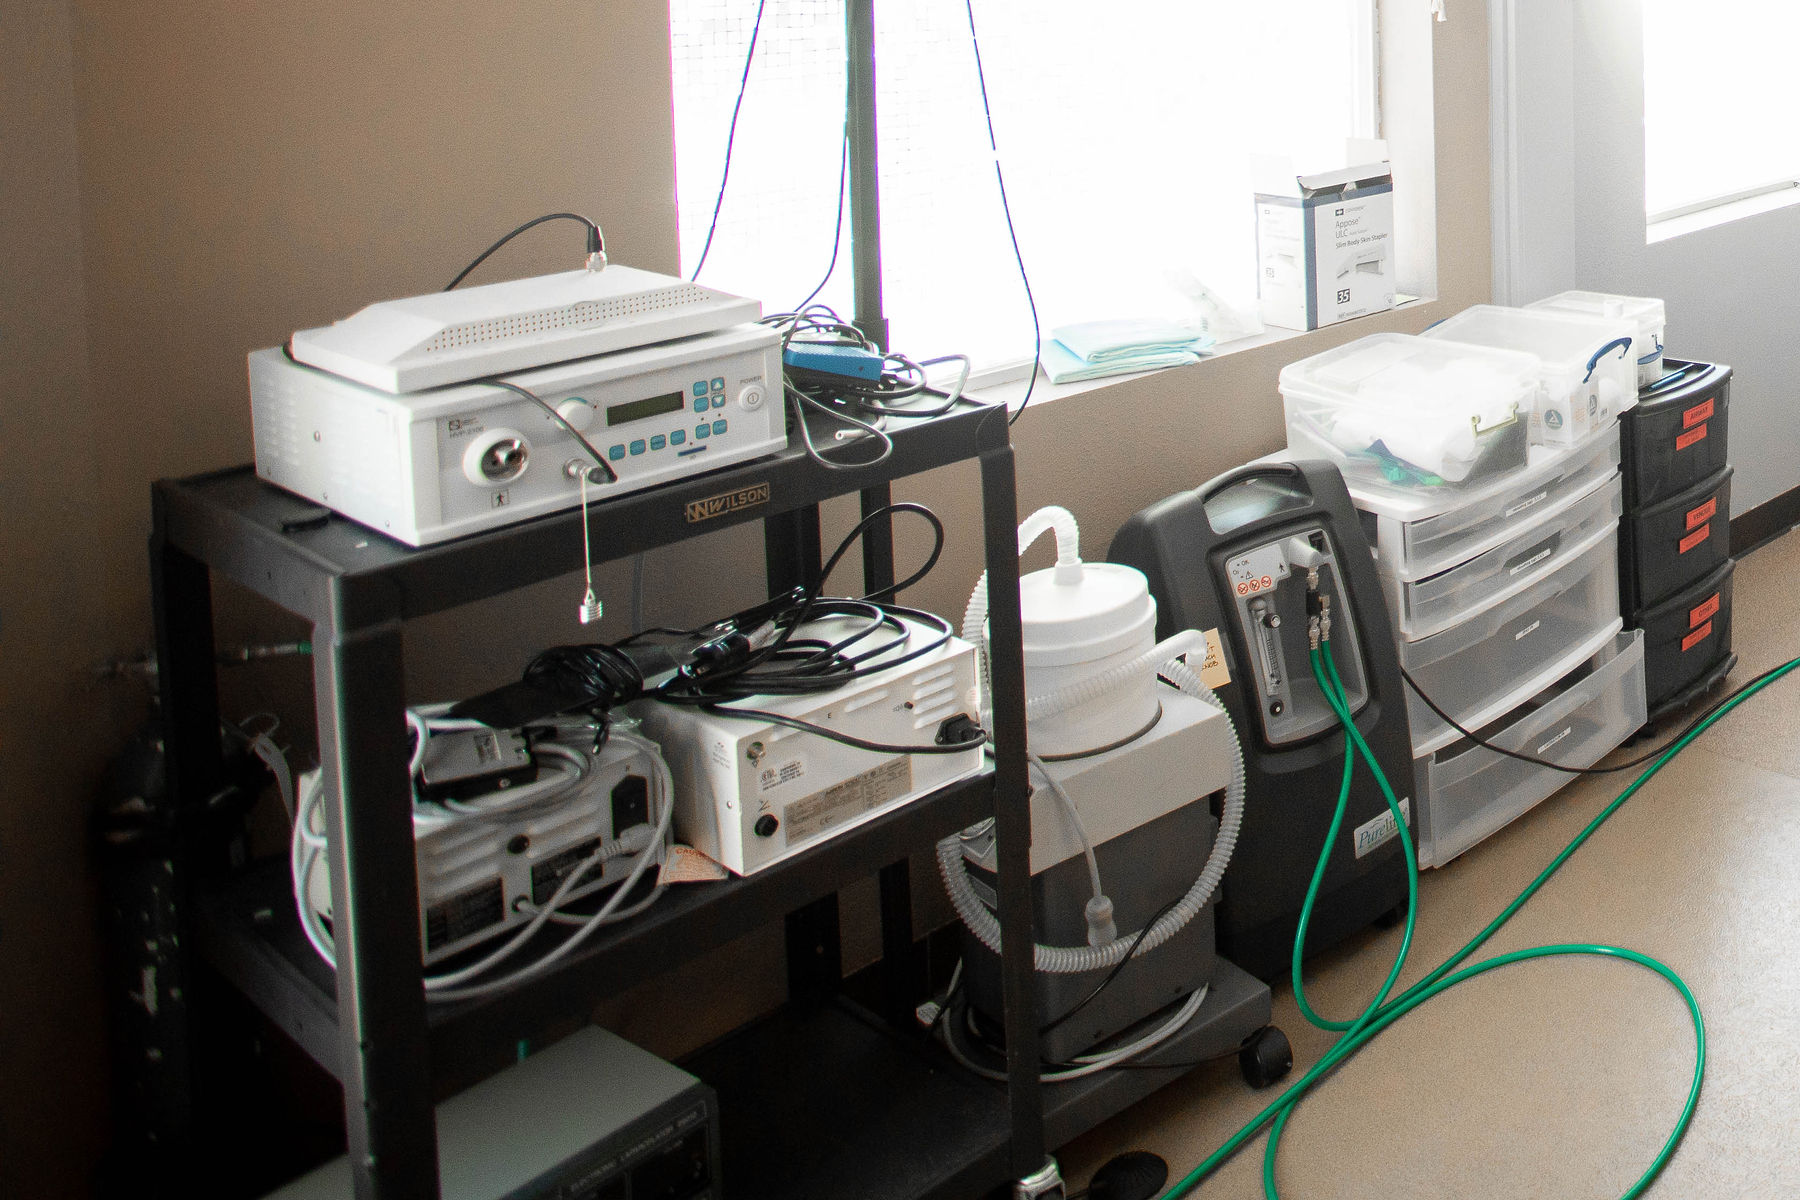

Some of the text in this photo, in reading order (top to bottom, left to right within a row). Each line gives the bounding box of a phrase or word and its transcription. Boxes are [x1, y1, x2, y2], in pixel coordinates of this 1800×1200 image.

[1335, 218, 1359, 229] Appose
[1335, 229, 1348, 239] ULC
[1335, 233, 1388, 249] Slim Body Skin Stapler
[1338, 290, 1349, 303] 35
[739, 375, 762, 385] POWER
[709, 486, 768, 513] WILSON
